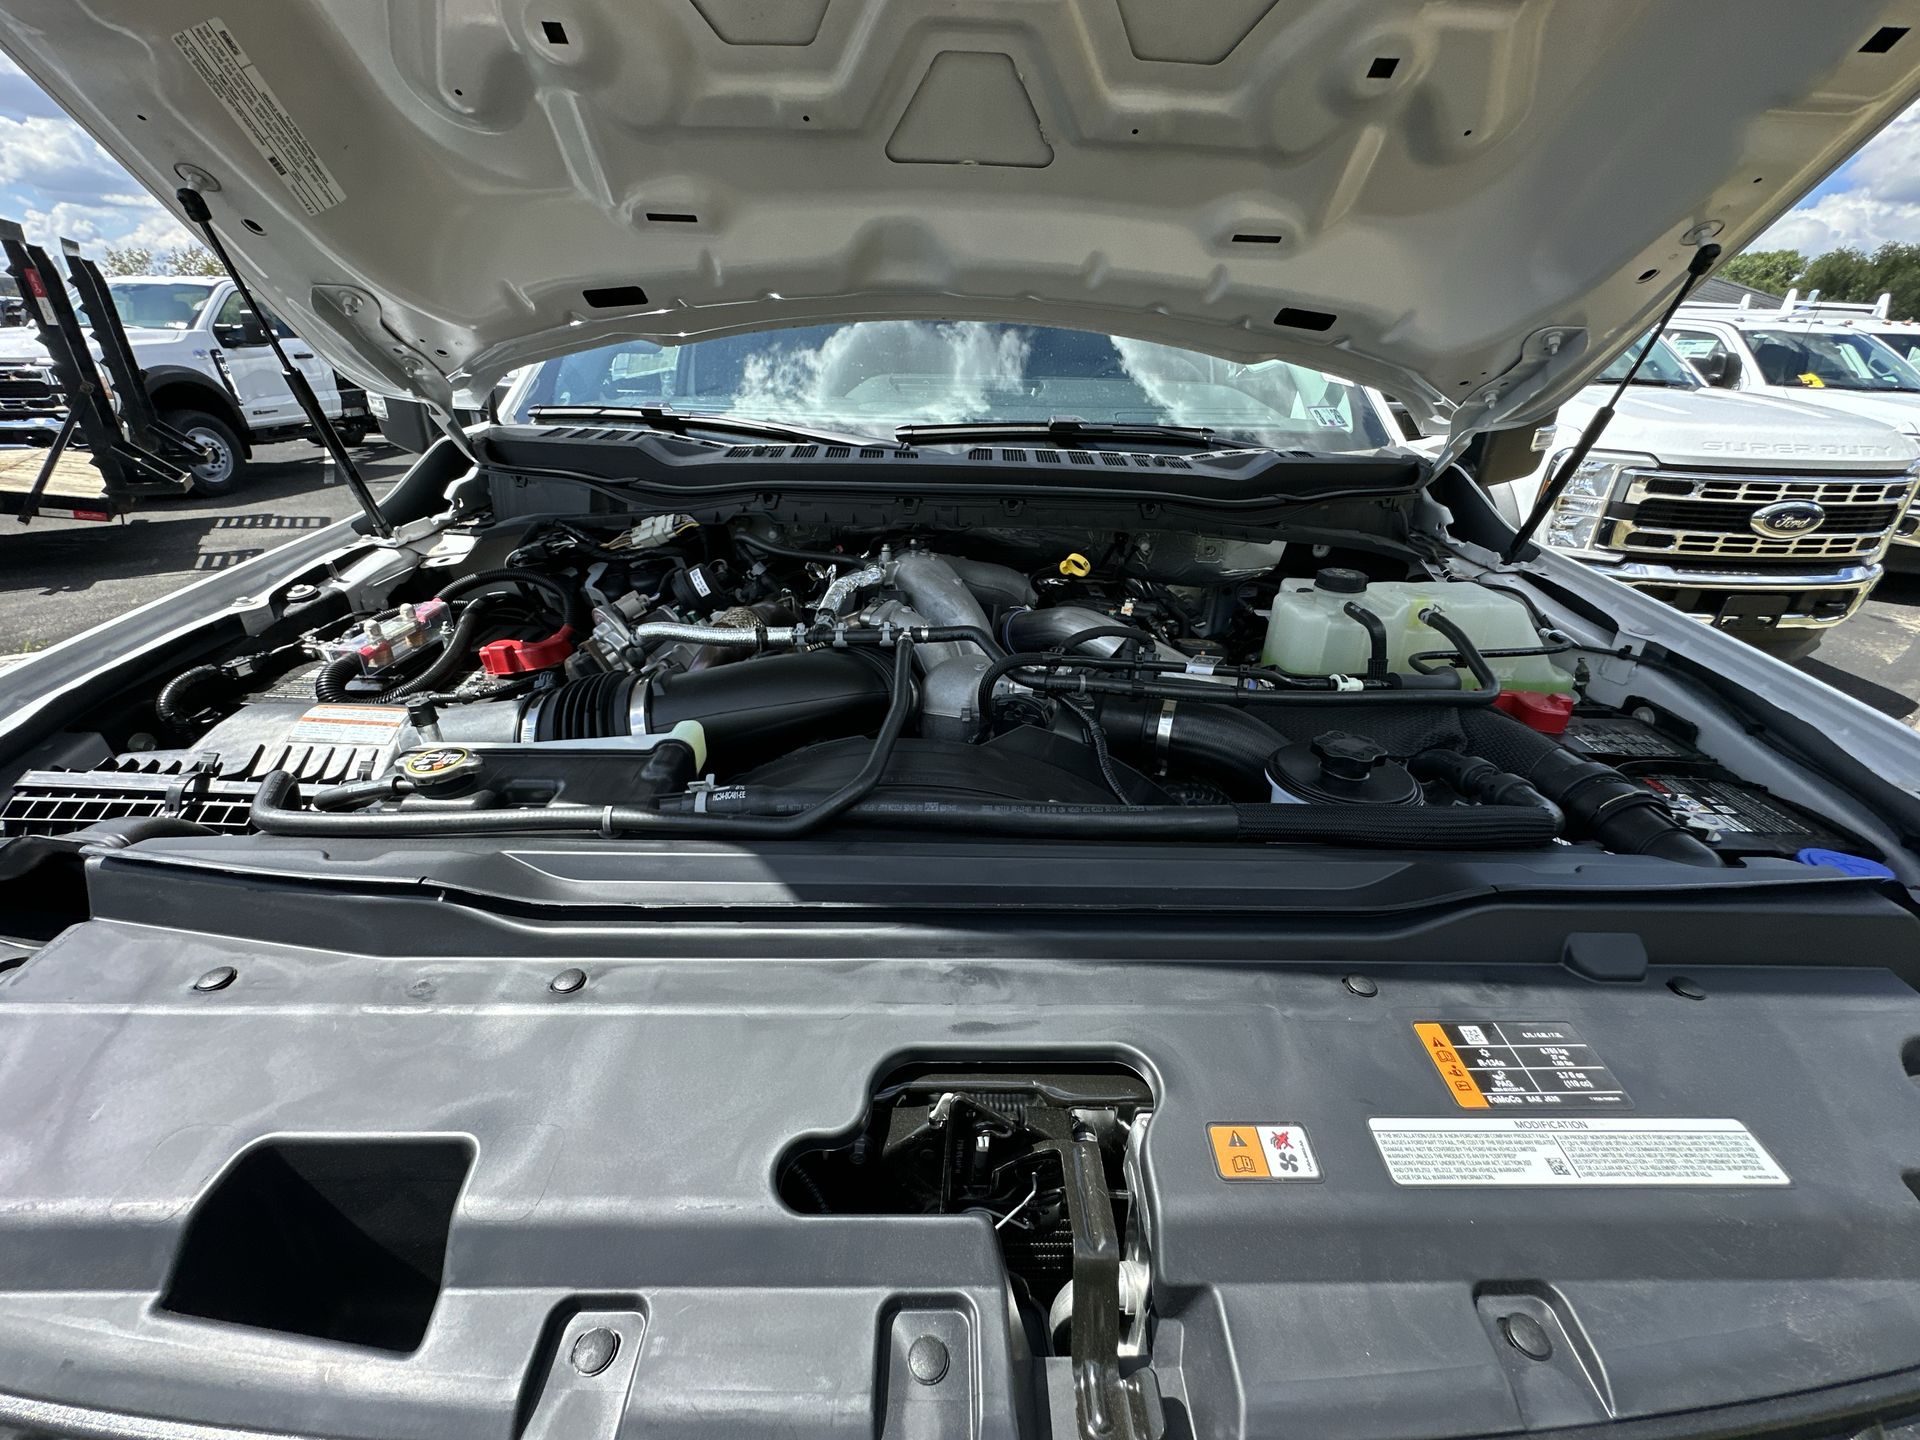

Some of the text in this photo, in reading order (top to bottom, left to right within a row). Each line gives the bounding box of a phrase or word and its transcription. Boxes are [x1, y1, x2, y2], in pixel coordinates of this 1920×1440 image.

[1774, 511, 1812, 529] Ford
[1487, 1095, 1523, 1103] FoMoCo
[1513, 1120, 1588, 1128] MODIFICATION
